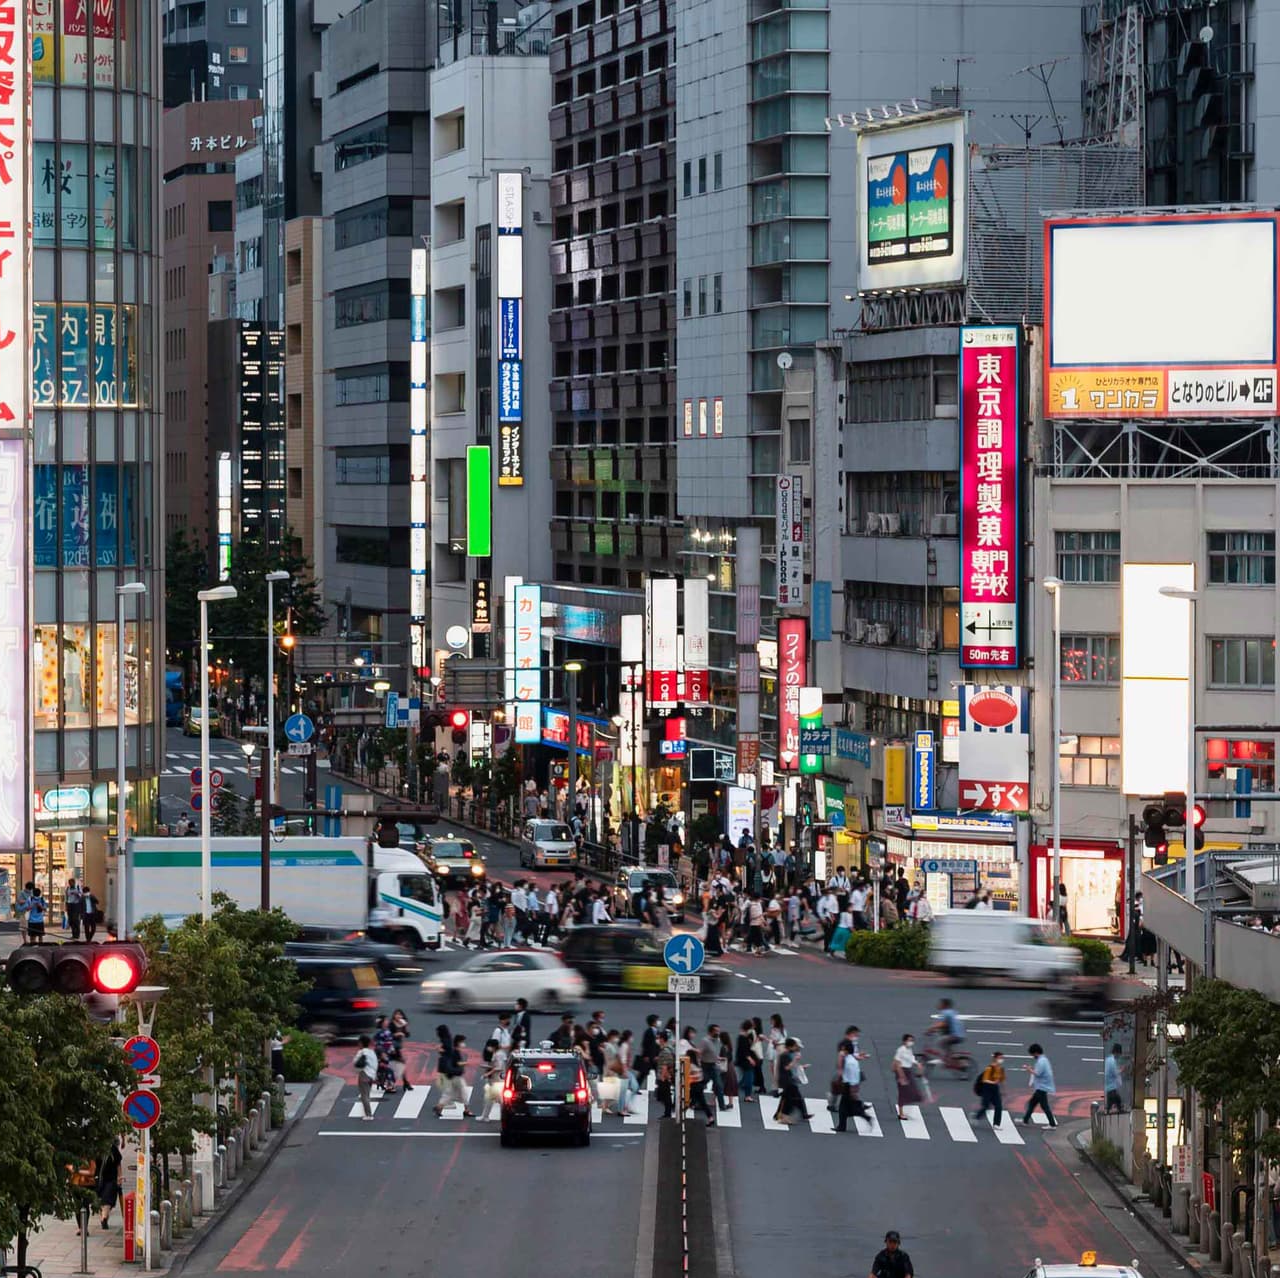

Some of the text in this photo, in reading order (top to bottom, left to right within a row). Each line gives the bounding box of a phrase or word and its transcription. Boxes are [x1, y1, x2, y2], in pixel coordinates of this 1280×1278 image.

[190, 135, 247, 151] 升本ビル
[1095, 376, 1159, 387] ひとりカラオケ専門店
[1171, 378, 1273, 404] となりのビル 4F
[1088, 389, 1160, 410] ワンカラ
[976, 353, 1003, 546] 東京調理製菓
[779, 542, 788, 584] iPhone
[970, 549, 1009, 573] 専門
[779, 585, 789, 604] 修理
[970, 573, 1009, 598] 学校
[517, 597, 535, 731] カラオケ館
[968, 649, 1010, 661] 50m先右
[658, 708, 672, 717] 2F
[802, 730, 830, 741] カラテ
[988, 783, 1023, 808] すぐ
